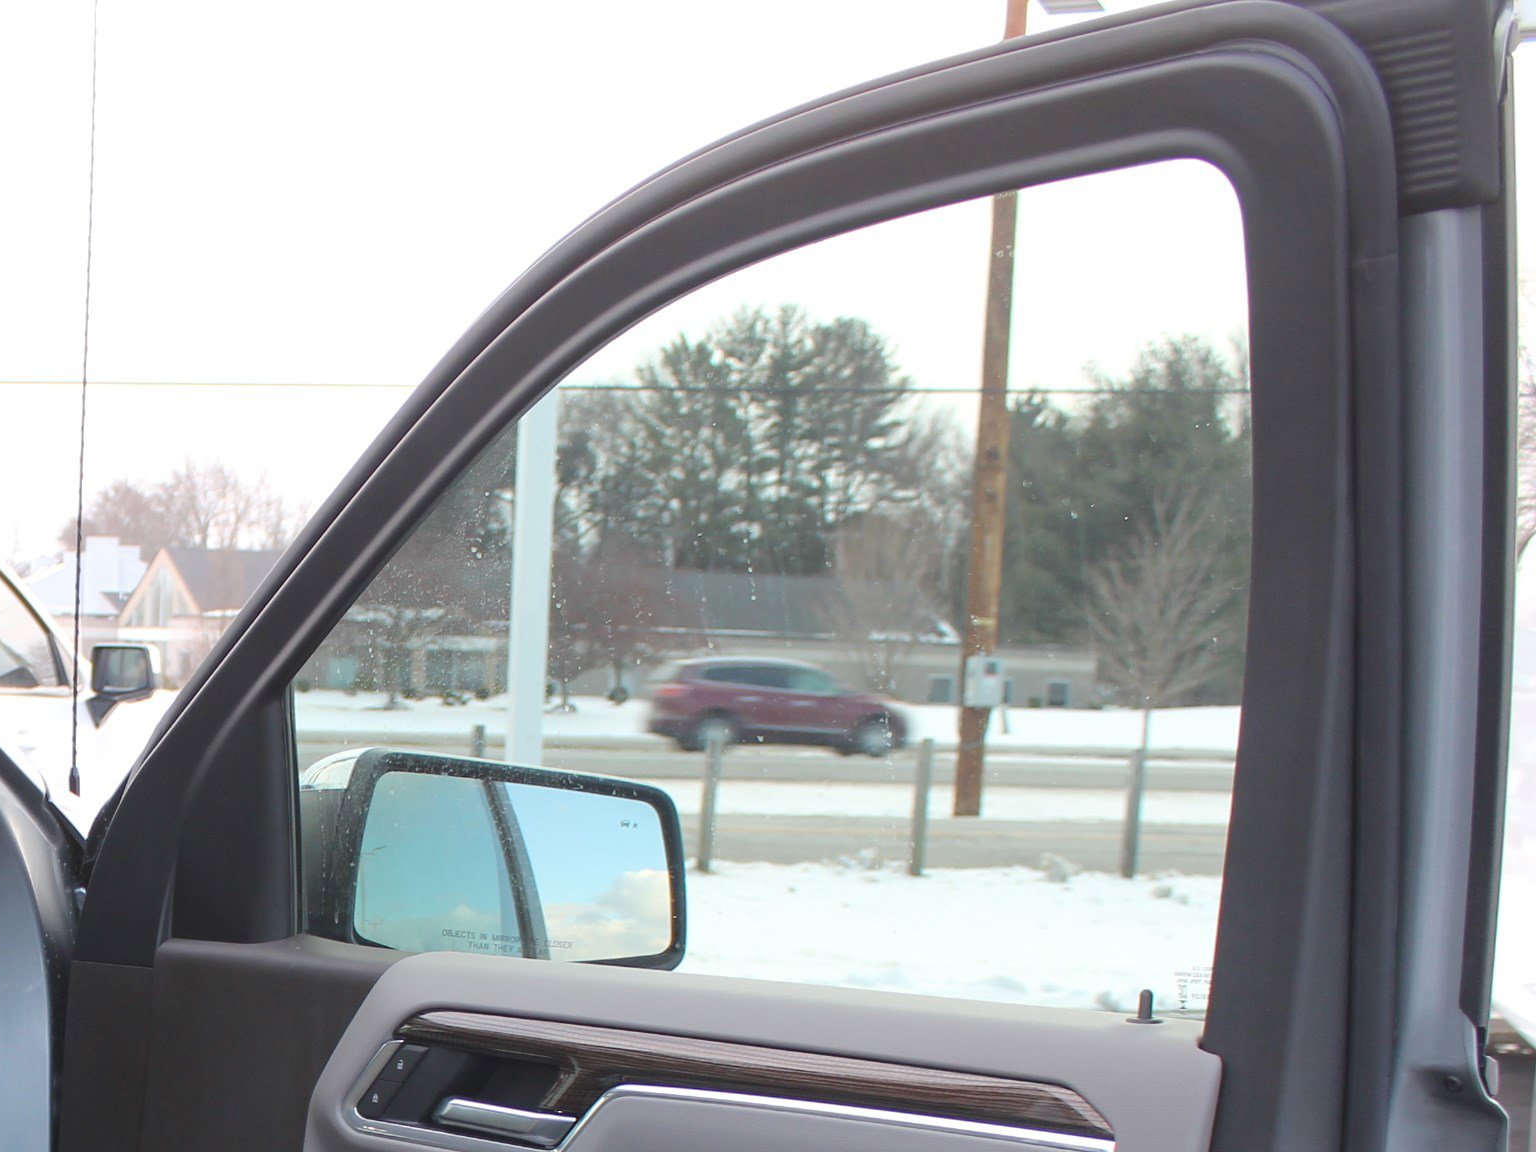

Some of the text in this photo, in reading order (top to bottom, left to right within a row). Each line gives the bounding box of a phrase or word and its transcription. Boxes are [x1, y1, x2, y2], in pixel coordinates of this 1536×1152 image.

[442, 929, 475, 940] OBJECTS
[479, 932, 488, 941] IN
[468, 940, 490, 950] THAN
[494, 943, 513, 952] THEY
